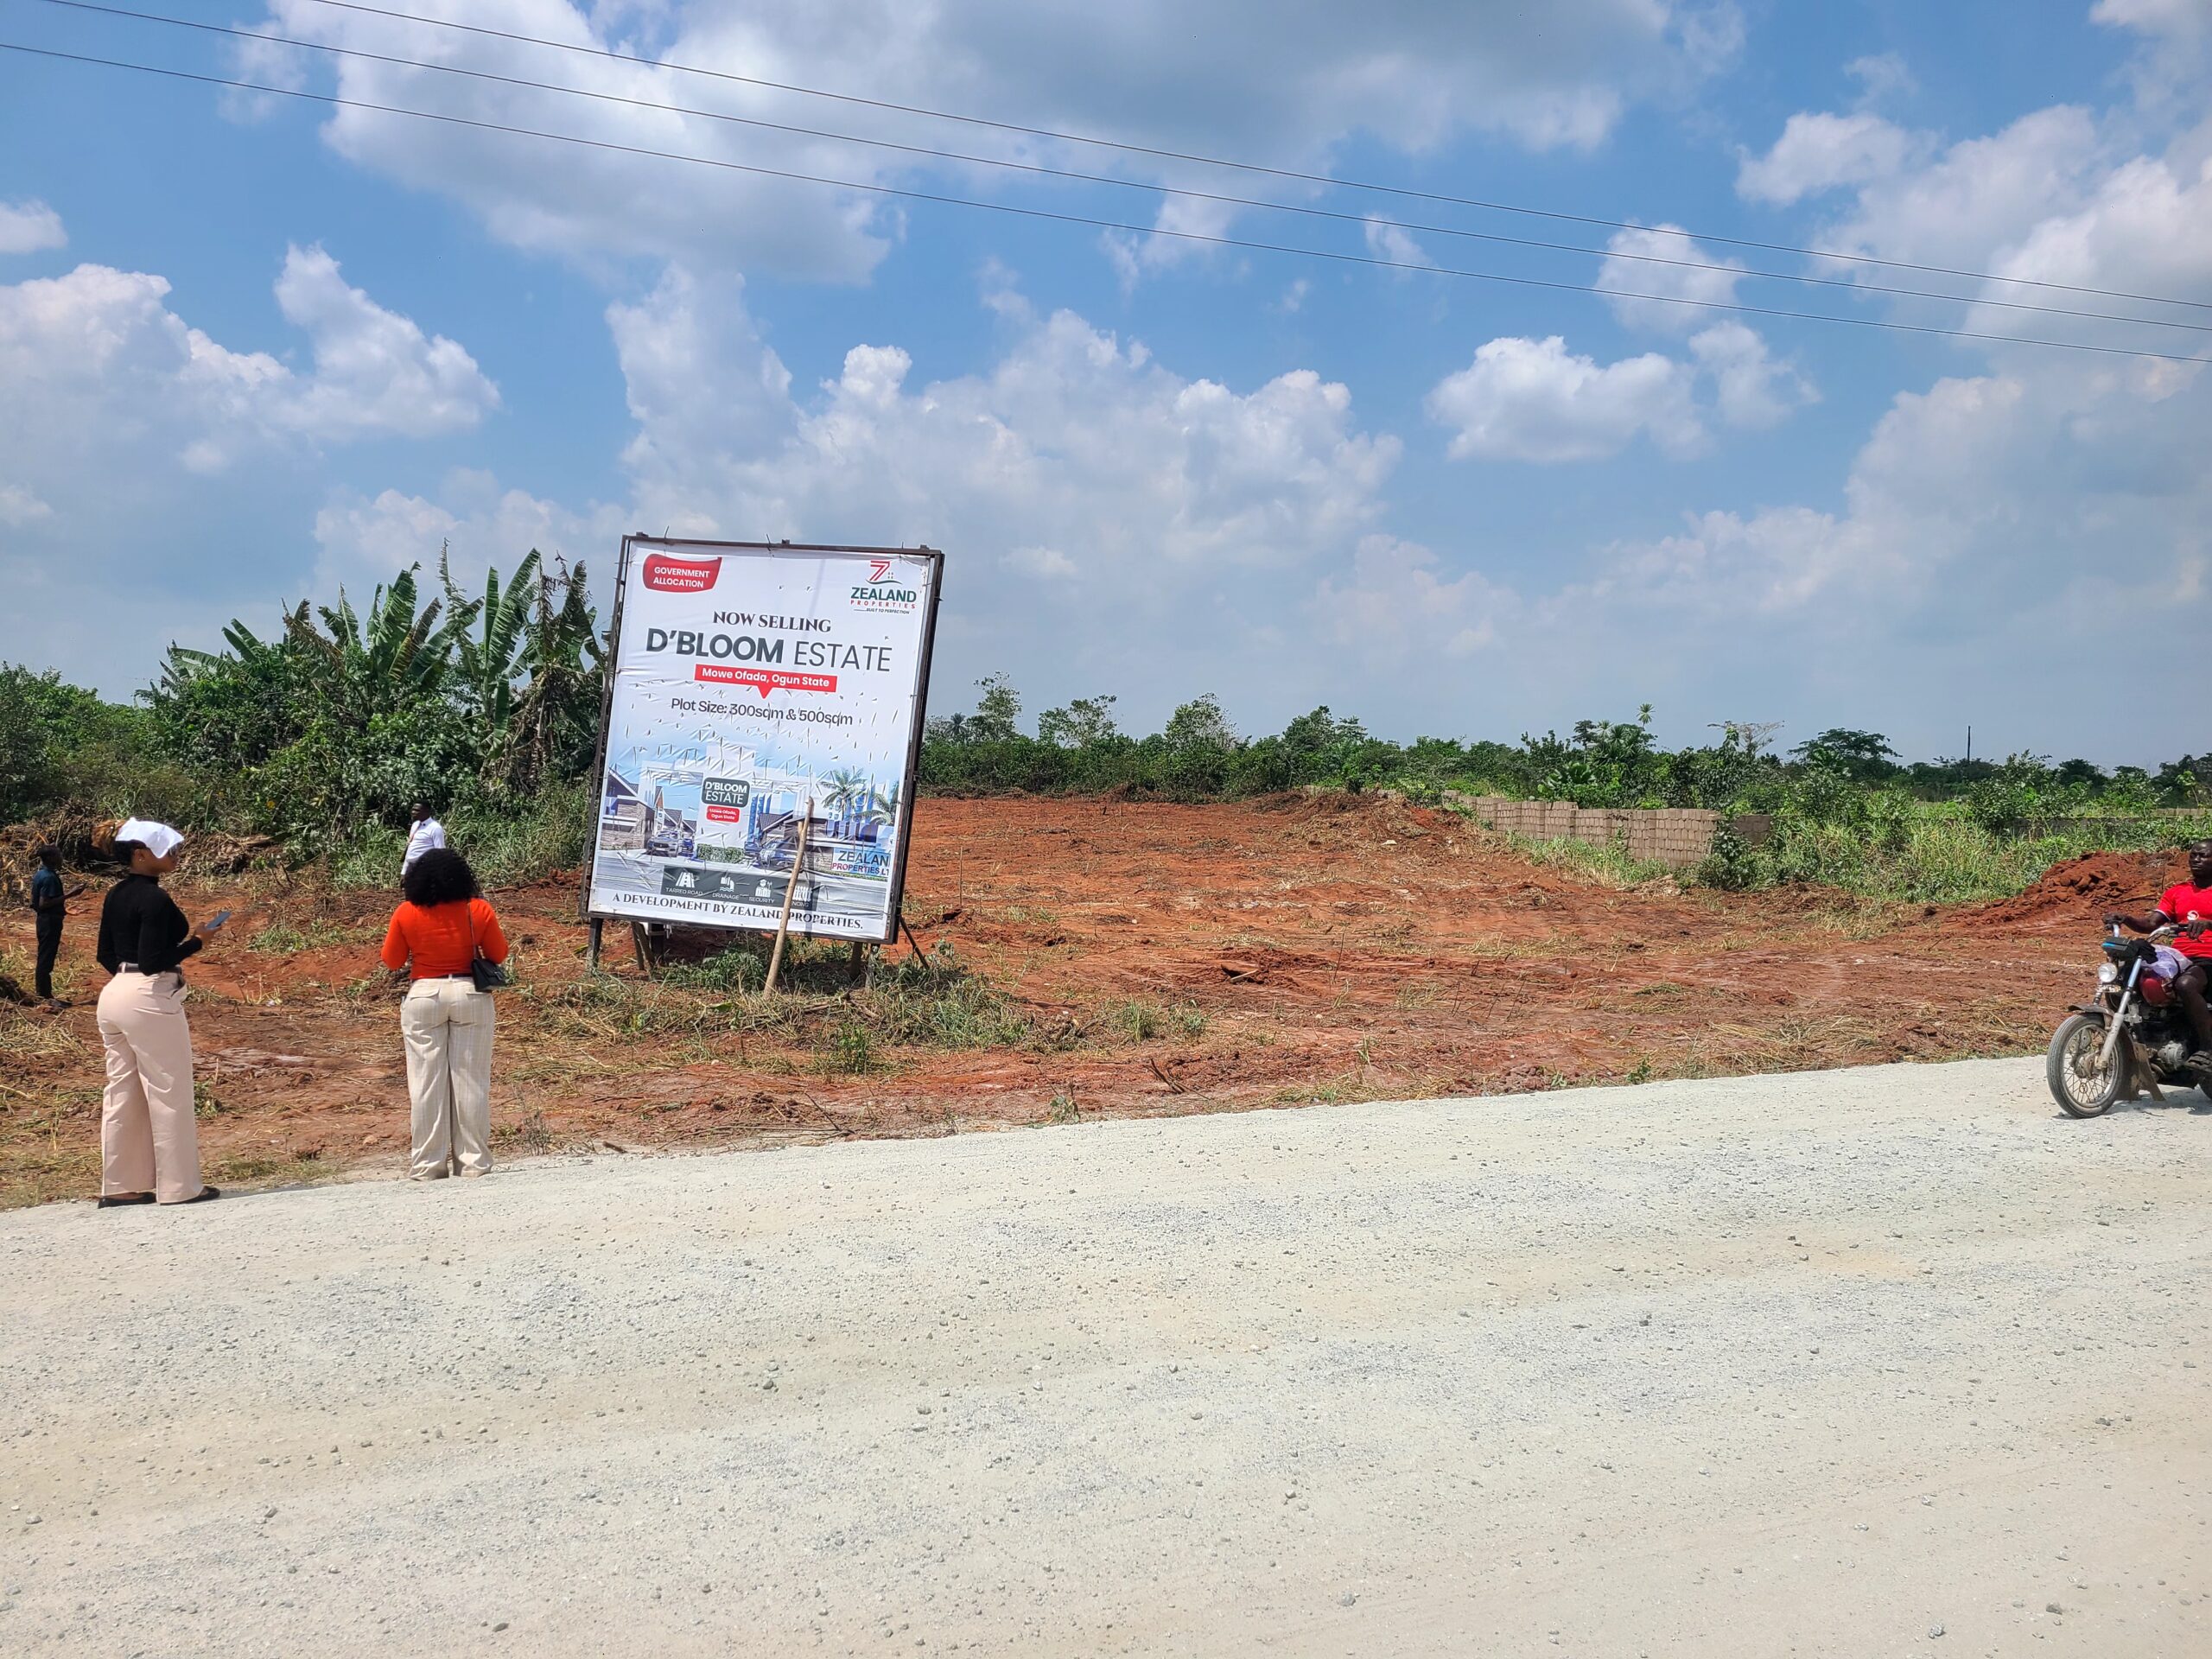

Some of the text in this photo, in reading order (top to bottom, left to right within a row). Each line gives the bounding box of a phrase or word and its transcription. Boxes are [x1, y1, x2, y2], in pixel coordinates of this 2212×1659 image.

[654, 567, 709, 578] GOVERNMENT
[653, 577, 703, 588] ALLOCATION
[850, 587, 917, 603] ZEALAND
[850, 600, 916, 609] PROPERTIES
[713, 611, 831, 632] NOW SELLING
[645, 627, 893, 672] D'BLOOM ESTATE
[702, 668, 830, 687] Mowe Ofada, Ogun State
[671, 697, 853, 727] Plot Size: 300sqm & 500sqm
[705, 790, 744, 804] ESTATE
[838, 850, 889, 868] ZEALAN
[831, 862, 880, 874] PROPERTIES
[613, 893, 863, 929] A DEVELOPMENT BY ZEALAND PROPERTIES.
